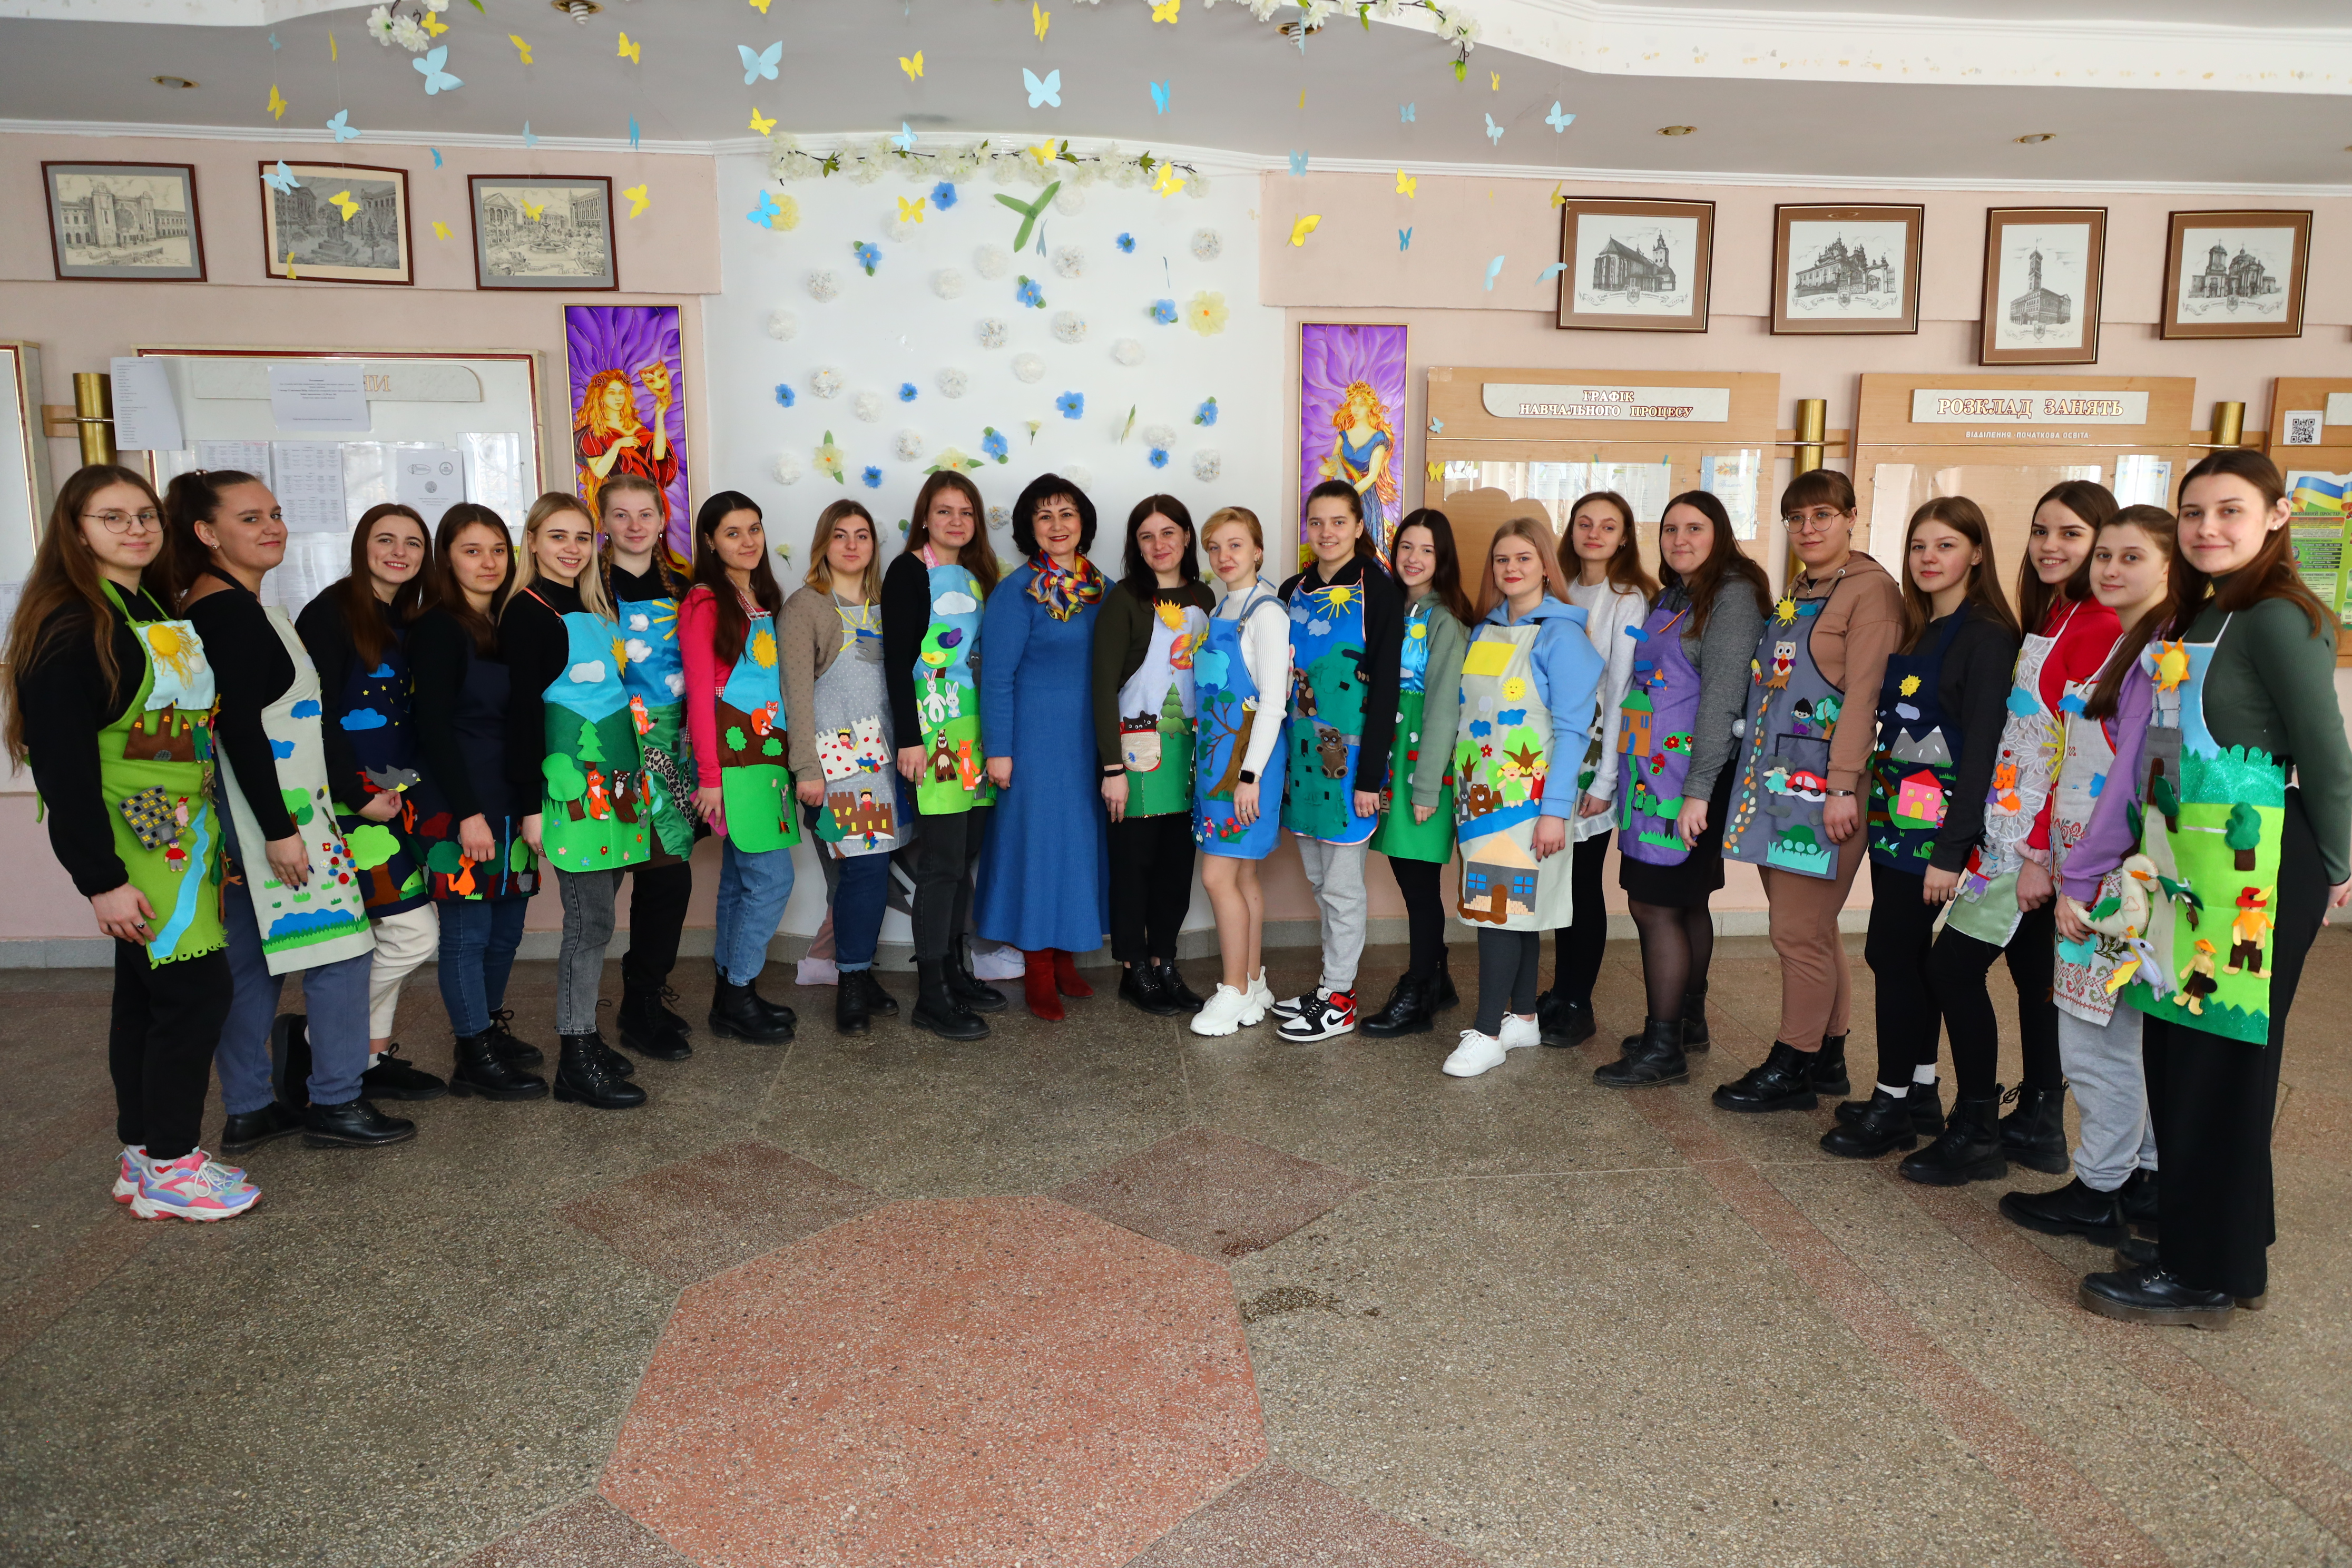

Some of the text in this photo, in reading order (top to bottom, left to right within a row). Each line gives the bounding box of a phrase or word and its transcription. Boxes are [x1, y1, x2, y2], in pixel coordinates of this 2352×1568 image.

[1583, 390, 1634, 402] ГРАФІК
[1520, 404, 1693, 419] НАВЧАЛЬНОГО ПРОЦЕСУ
[1937, 398, 2124, 418] РОЗКЛАД ЗАНЯТЬ
